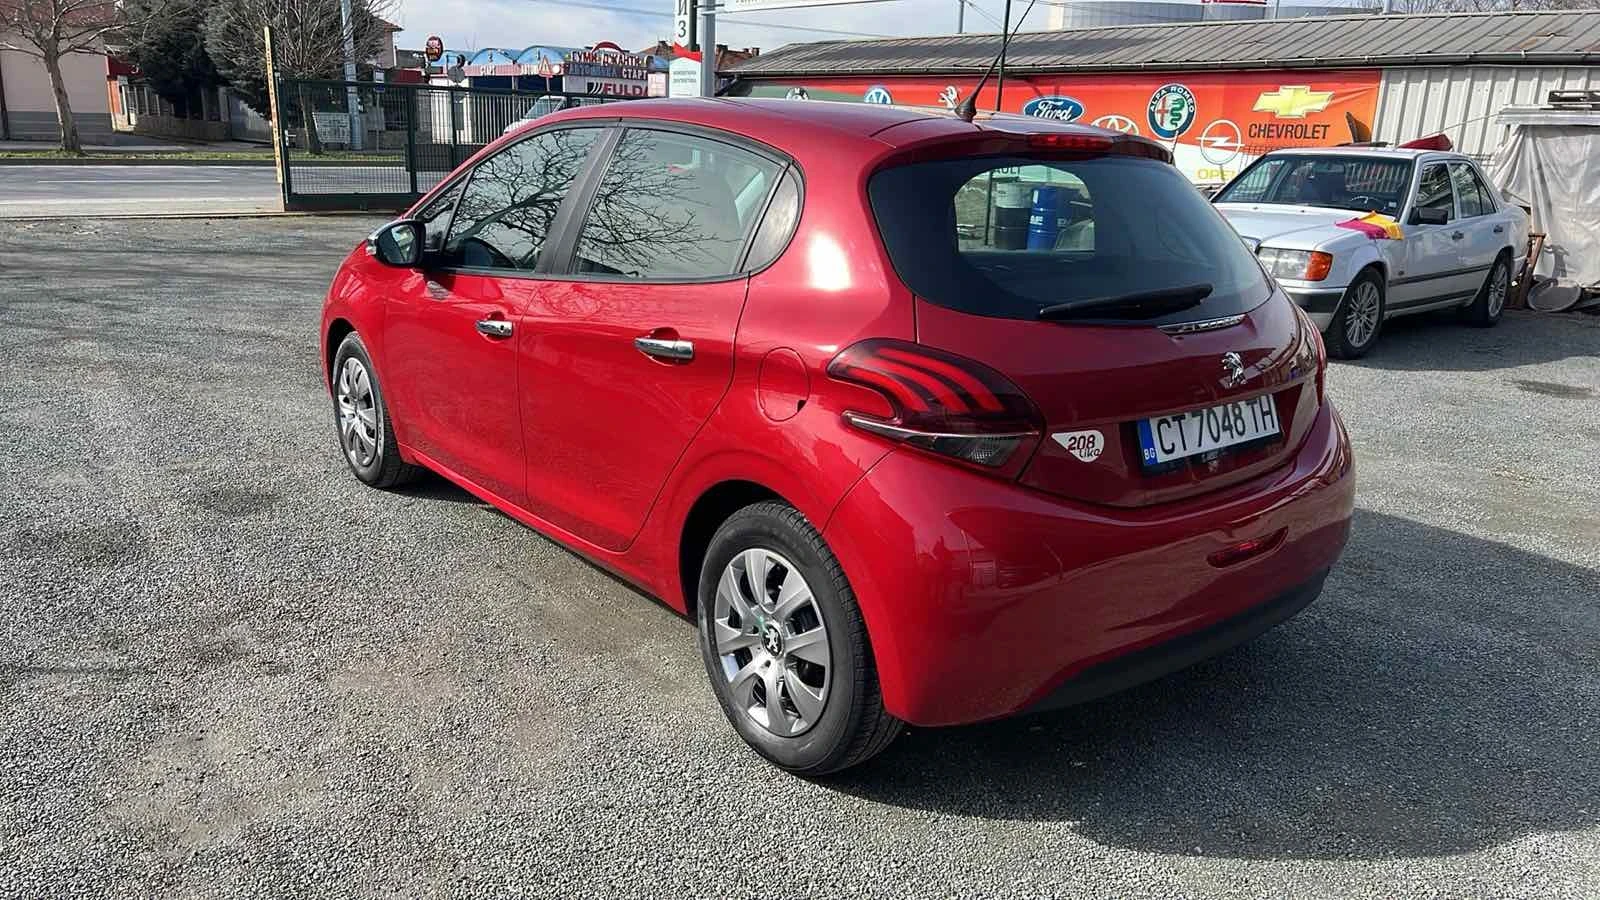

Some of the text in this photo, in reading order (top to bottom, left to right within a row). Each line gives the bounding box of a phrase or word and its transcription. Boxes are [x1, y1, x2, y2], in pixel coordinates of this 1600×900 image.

[622, 68, 648, 79] СТАРТ
[1150, 86, 1195, 113] ALFA ROMEO
[1034, 100, 1073, 121] Ford
[1248, 123, 1330, 140] CHEVROLET
[1156, 394, 1276, 455] CT 7048 TH
[1067, 434, 1096, 451] 208
[1143, 448, 1156, 460] BG
